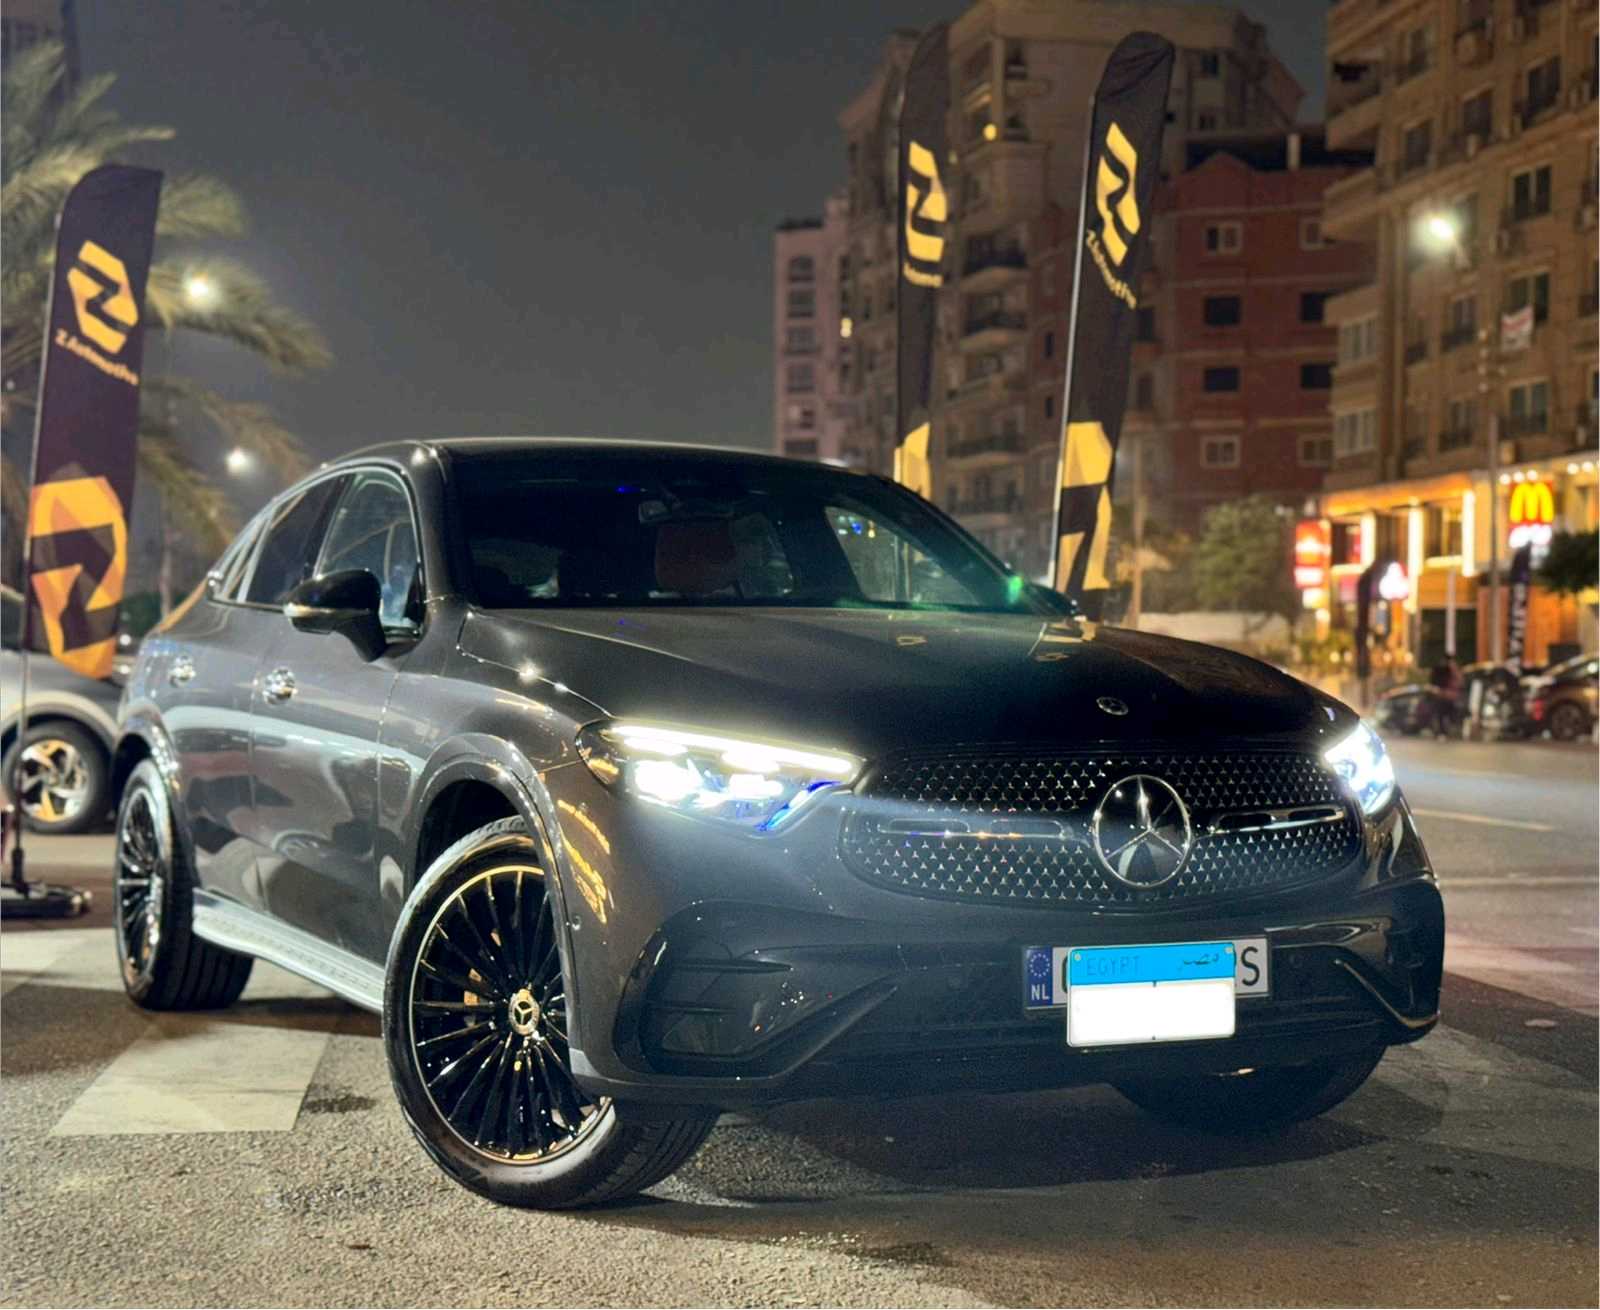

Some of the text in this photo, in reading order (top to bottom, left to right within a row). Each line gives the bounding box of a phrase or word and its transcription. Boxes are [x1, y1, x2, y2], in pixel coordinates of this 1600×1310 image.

[1087, 955, 1141, 977] EGYPT
[1234, 946, 1260, 986] S
[1031, 984, 1049, 1001] NL
